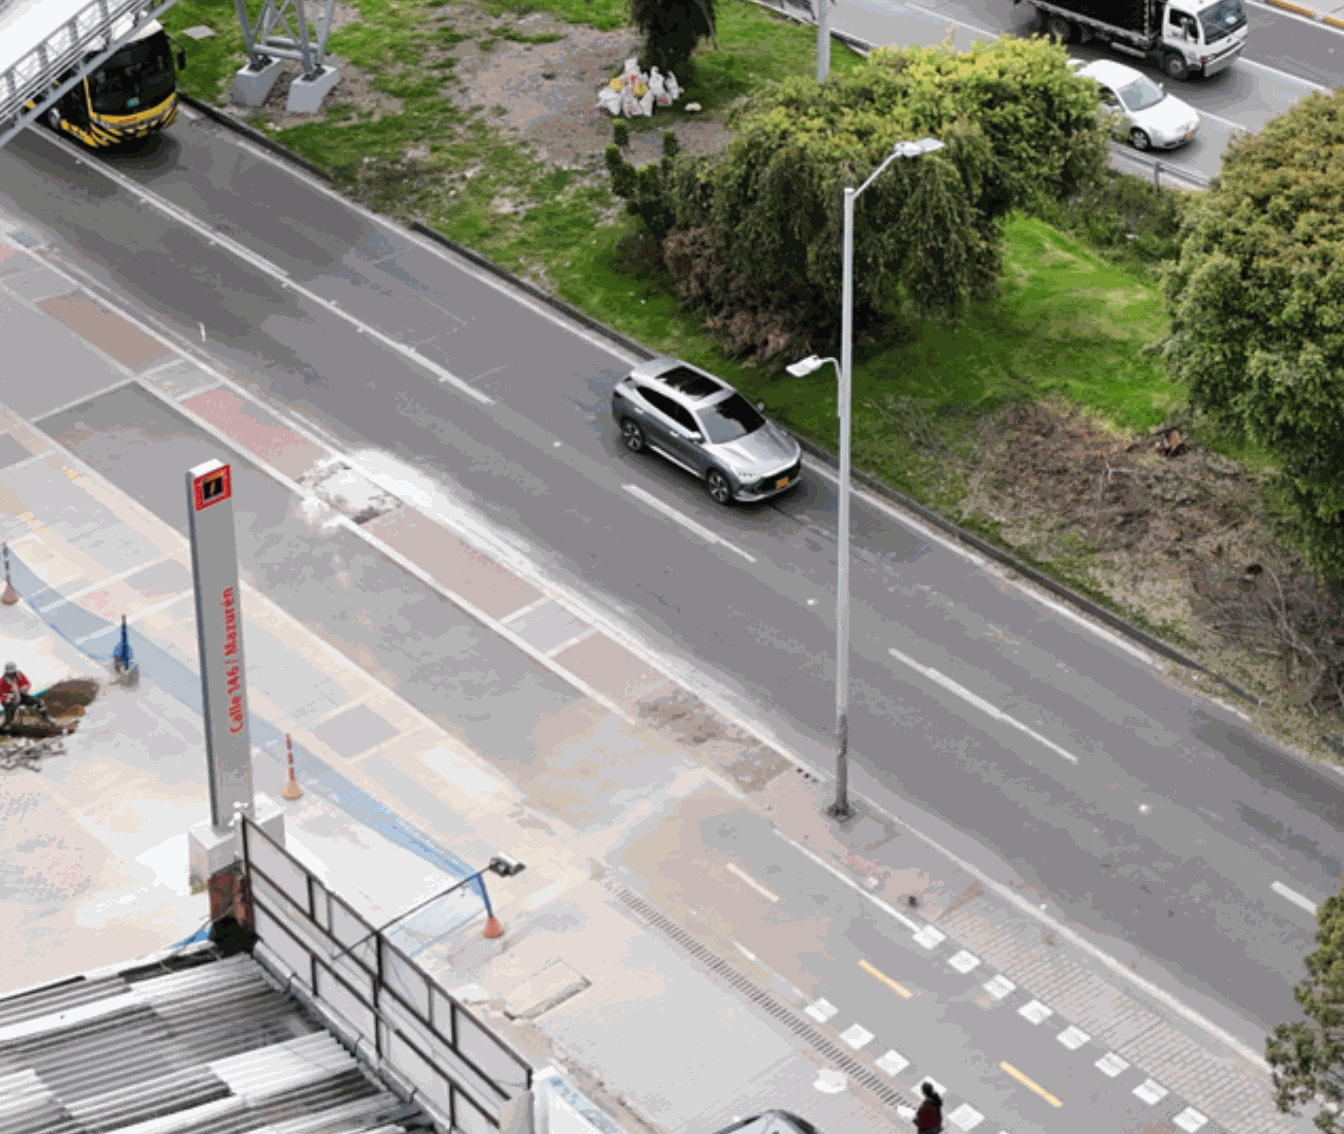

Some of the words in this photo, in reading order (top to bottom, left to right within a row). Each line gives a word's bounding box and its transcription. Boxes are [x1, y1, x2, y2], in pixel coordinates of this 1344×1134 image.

[218, 586, 237, 656] Mazurén
[225, 665, 240, 695] 146
[228, 695, 243, 734] Calle
